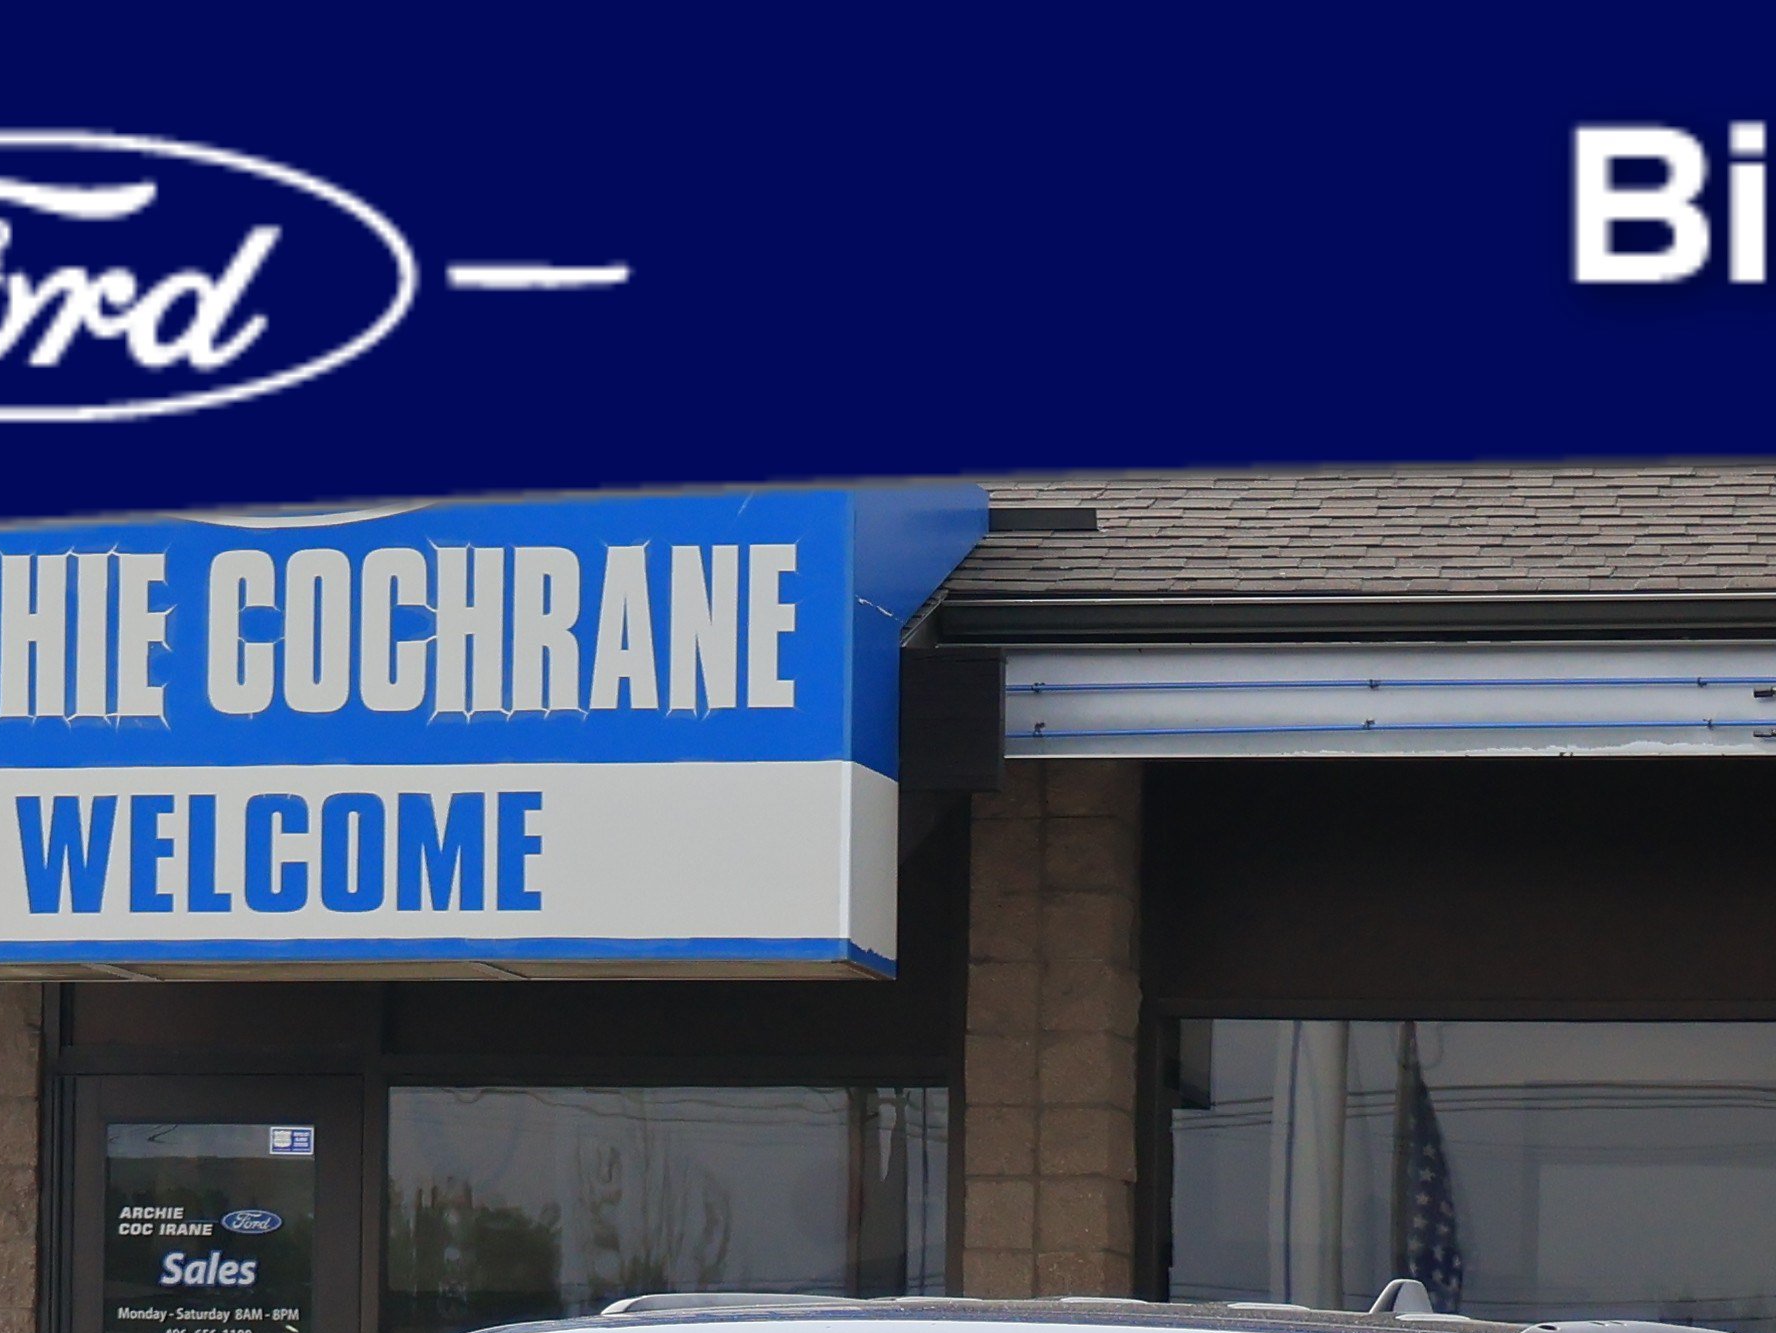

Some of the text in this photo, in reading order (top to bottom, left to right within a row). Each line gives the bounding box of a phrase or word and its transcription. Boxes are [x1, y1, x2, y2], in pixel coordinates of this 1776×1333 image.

[207, 544, 797, 717] COCHRANE
[16, 790, 545, 916] WELCOME
[118, 1207, 184, 1220] ARCHIE
[232, 1213, 270, 1231] Ford
[159, 1250, 258, 1286] Sales
[117, 1307, 168, 1323] Monday
[176, 1307, 231, 1323] Saturday
[235, 1308, 263, 1321] 8AM
